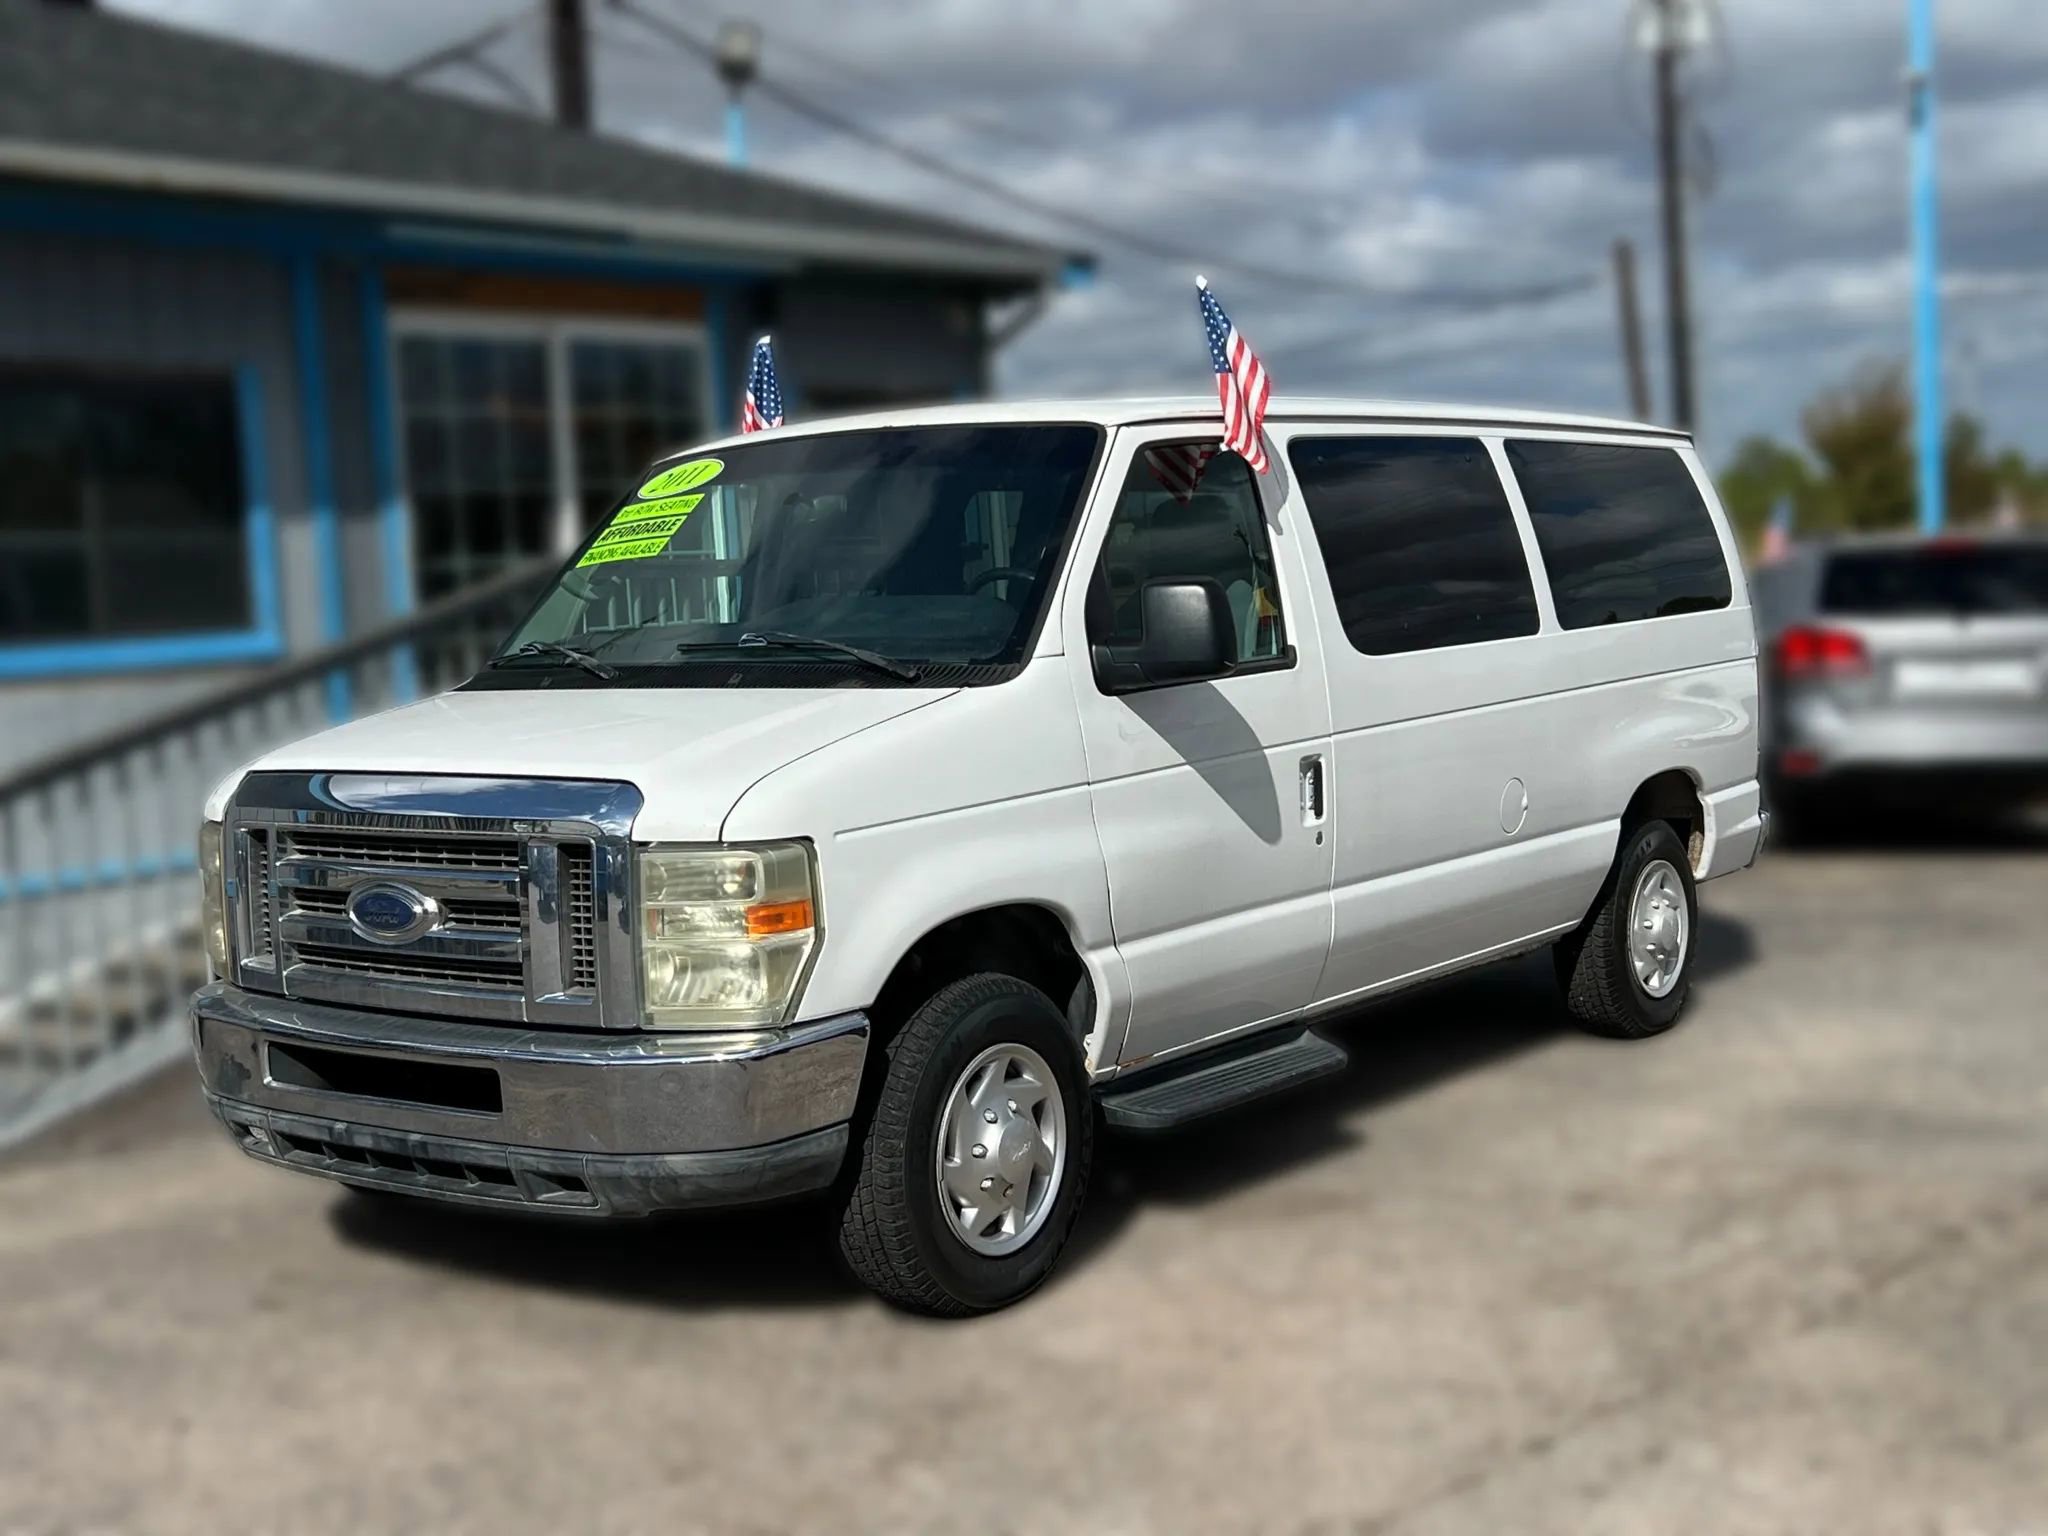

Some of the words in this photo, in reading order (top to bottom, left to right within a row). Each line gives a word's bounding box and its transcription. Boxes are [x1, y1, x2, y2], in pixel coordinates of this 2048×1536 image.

[648, 463, 712, 494] 2011
[657, 497, 699, 512] SEATING
[599, 518, 681, 543] AFFORDABLE
[620, 541, 664, 557] AVAILABLE
